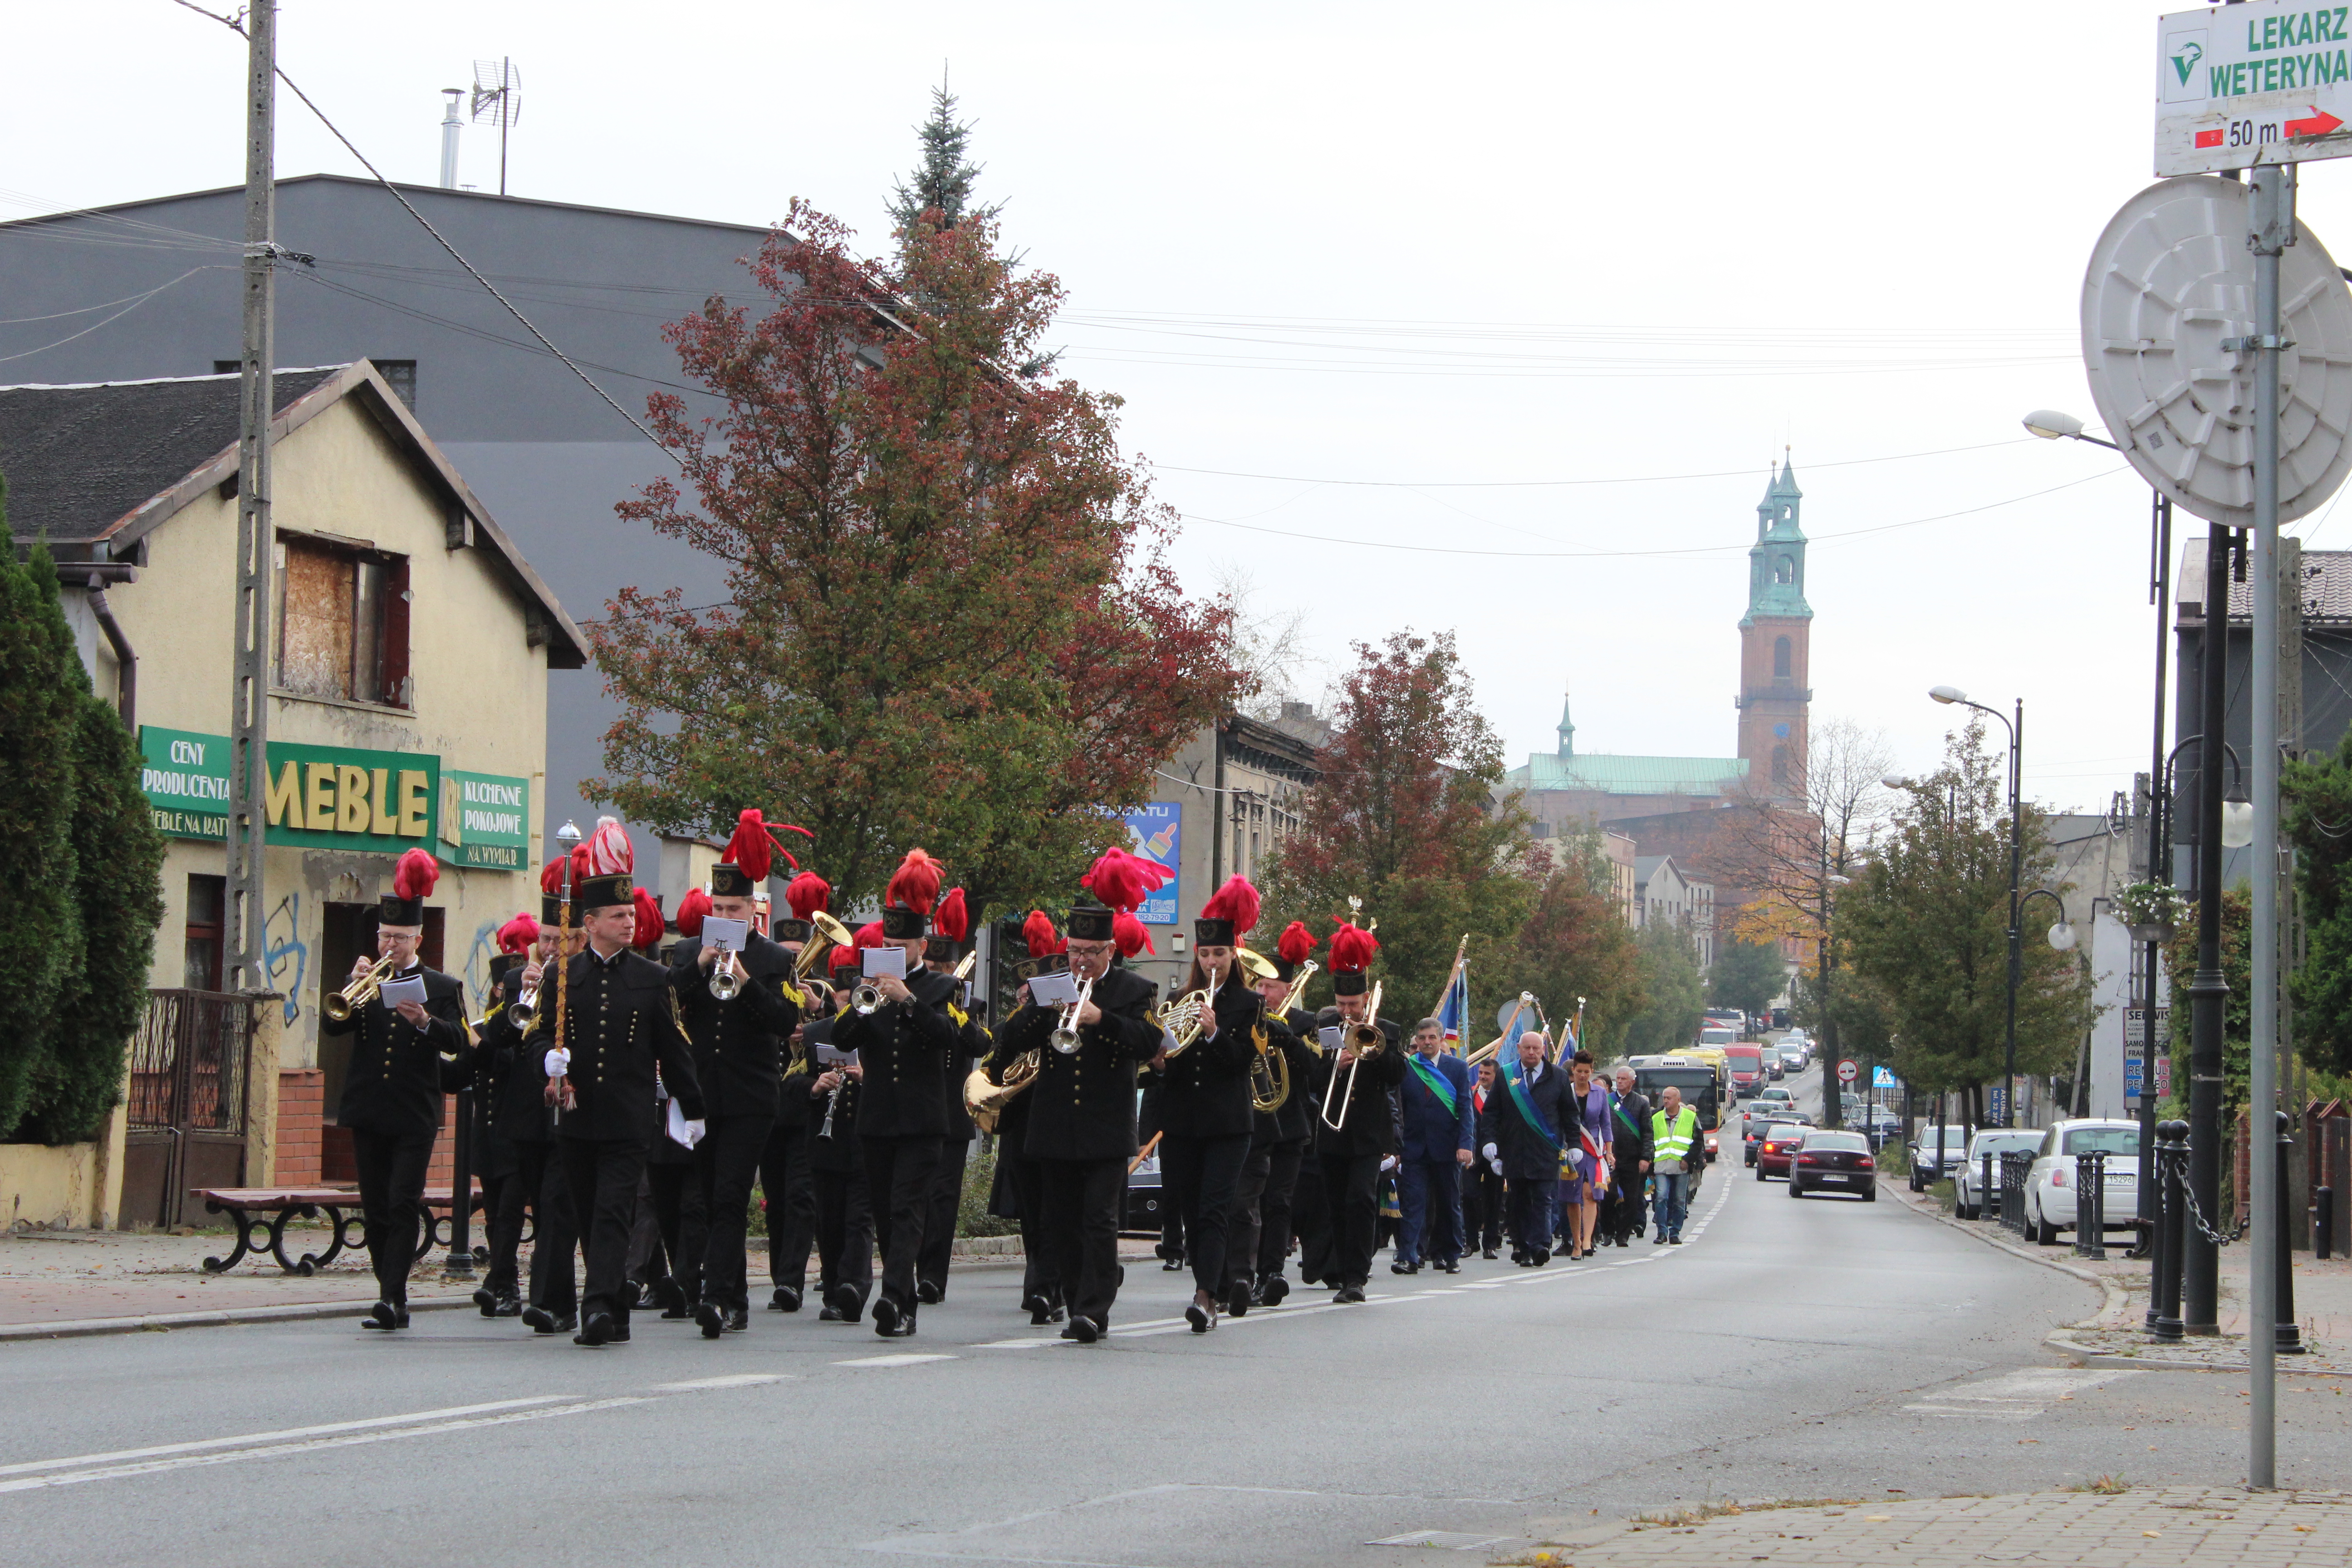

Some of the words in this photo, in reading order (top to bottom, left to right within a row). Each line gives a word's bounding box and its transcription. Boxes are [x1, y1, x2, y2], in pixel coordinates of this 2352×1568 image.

[2248, 6, 2348, 52] LEKARZ
[2210, 49, 2352, 98] WETERYNA
[2230, 119, 2253, 147] 50
[2259, 122, 2277, 145] m
[171, 740, 206, 765] CENY
[264, 760, 429, 838] MEBLE
[465, 780, 521, 806] KUCHENNE
[150, 810, 182, 832] EBLE
[185, 814, 200, 834] NA
[465, 809, 521, 835] POKOJOWE
[468, 845, 480, 863] NA
[482, 846, 517, 866] WYMIAR
